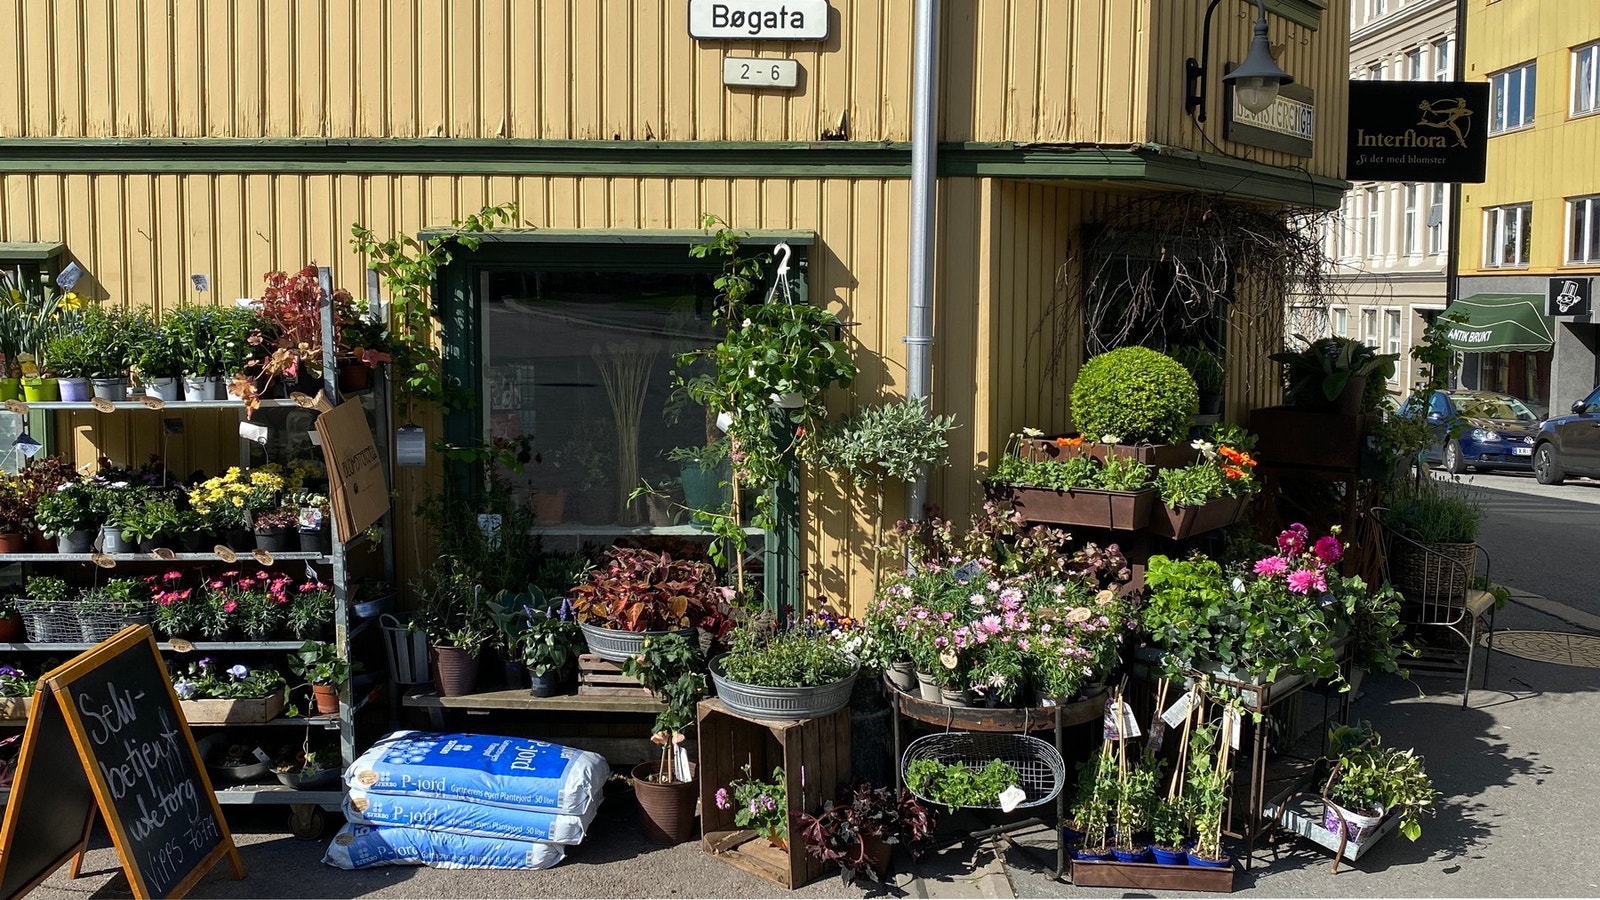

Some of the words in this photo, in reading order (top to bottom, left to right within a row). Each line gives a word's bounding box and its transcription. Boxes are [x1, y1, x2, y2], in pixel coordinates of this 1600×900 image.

[712, 4, 804, 35] Bøgata
[741, 64, 750, 79] 2
[771, 65, 780, 80] 6
[1237, 100, 1312, 136] BSTERENGA
[1357, 129, 1447, 148] Interflora
[1356, 154, 1367, 165] Si
[1370, 155, 1384, 163] det
[1387, 155, 1405, 163] med
[1408, 155, 1446, 164] blomster
[1448, 328, 1470, 342] ANTIK
[1469, 330, 1493, 342] BRUKT
[402, 774, 446, 792] P-jord
[394, 806, 438, 823] P-jord
